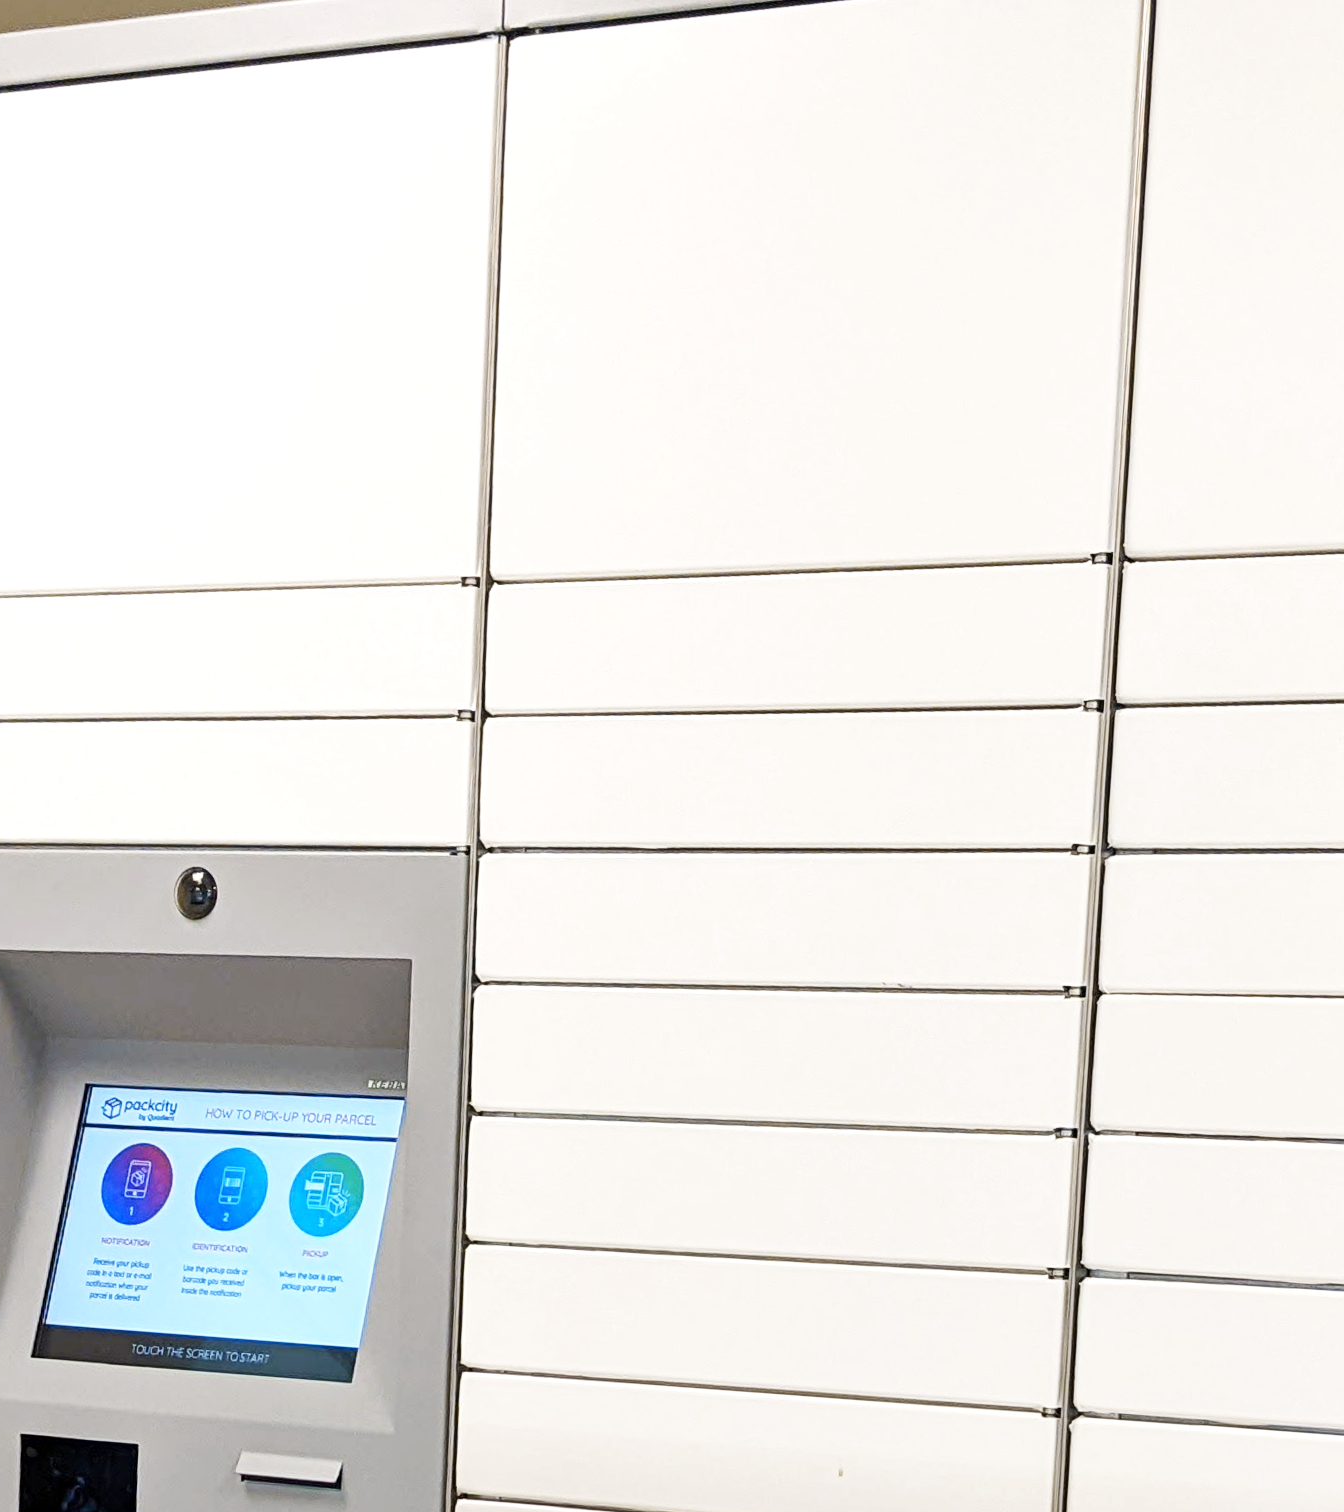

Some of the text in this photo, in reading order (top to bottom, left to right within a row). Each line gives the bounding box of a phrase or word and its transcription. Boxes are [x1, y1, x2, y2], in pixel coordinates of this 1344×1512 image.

[124, 1098, 178, 1115] packcity
[205, 1108, 377, 1126] HOW TO PICK-UP YOUR PARCEL
[222, 1212, 230, 1222] 2
[318, 1217, 325, 1227] 3
[131, 1344, 269, 1364] TOUCH THE SCREEN TO START
